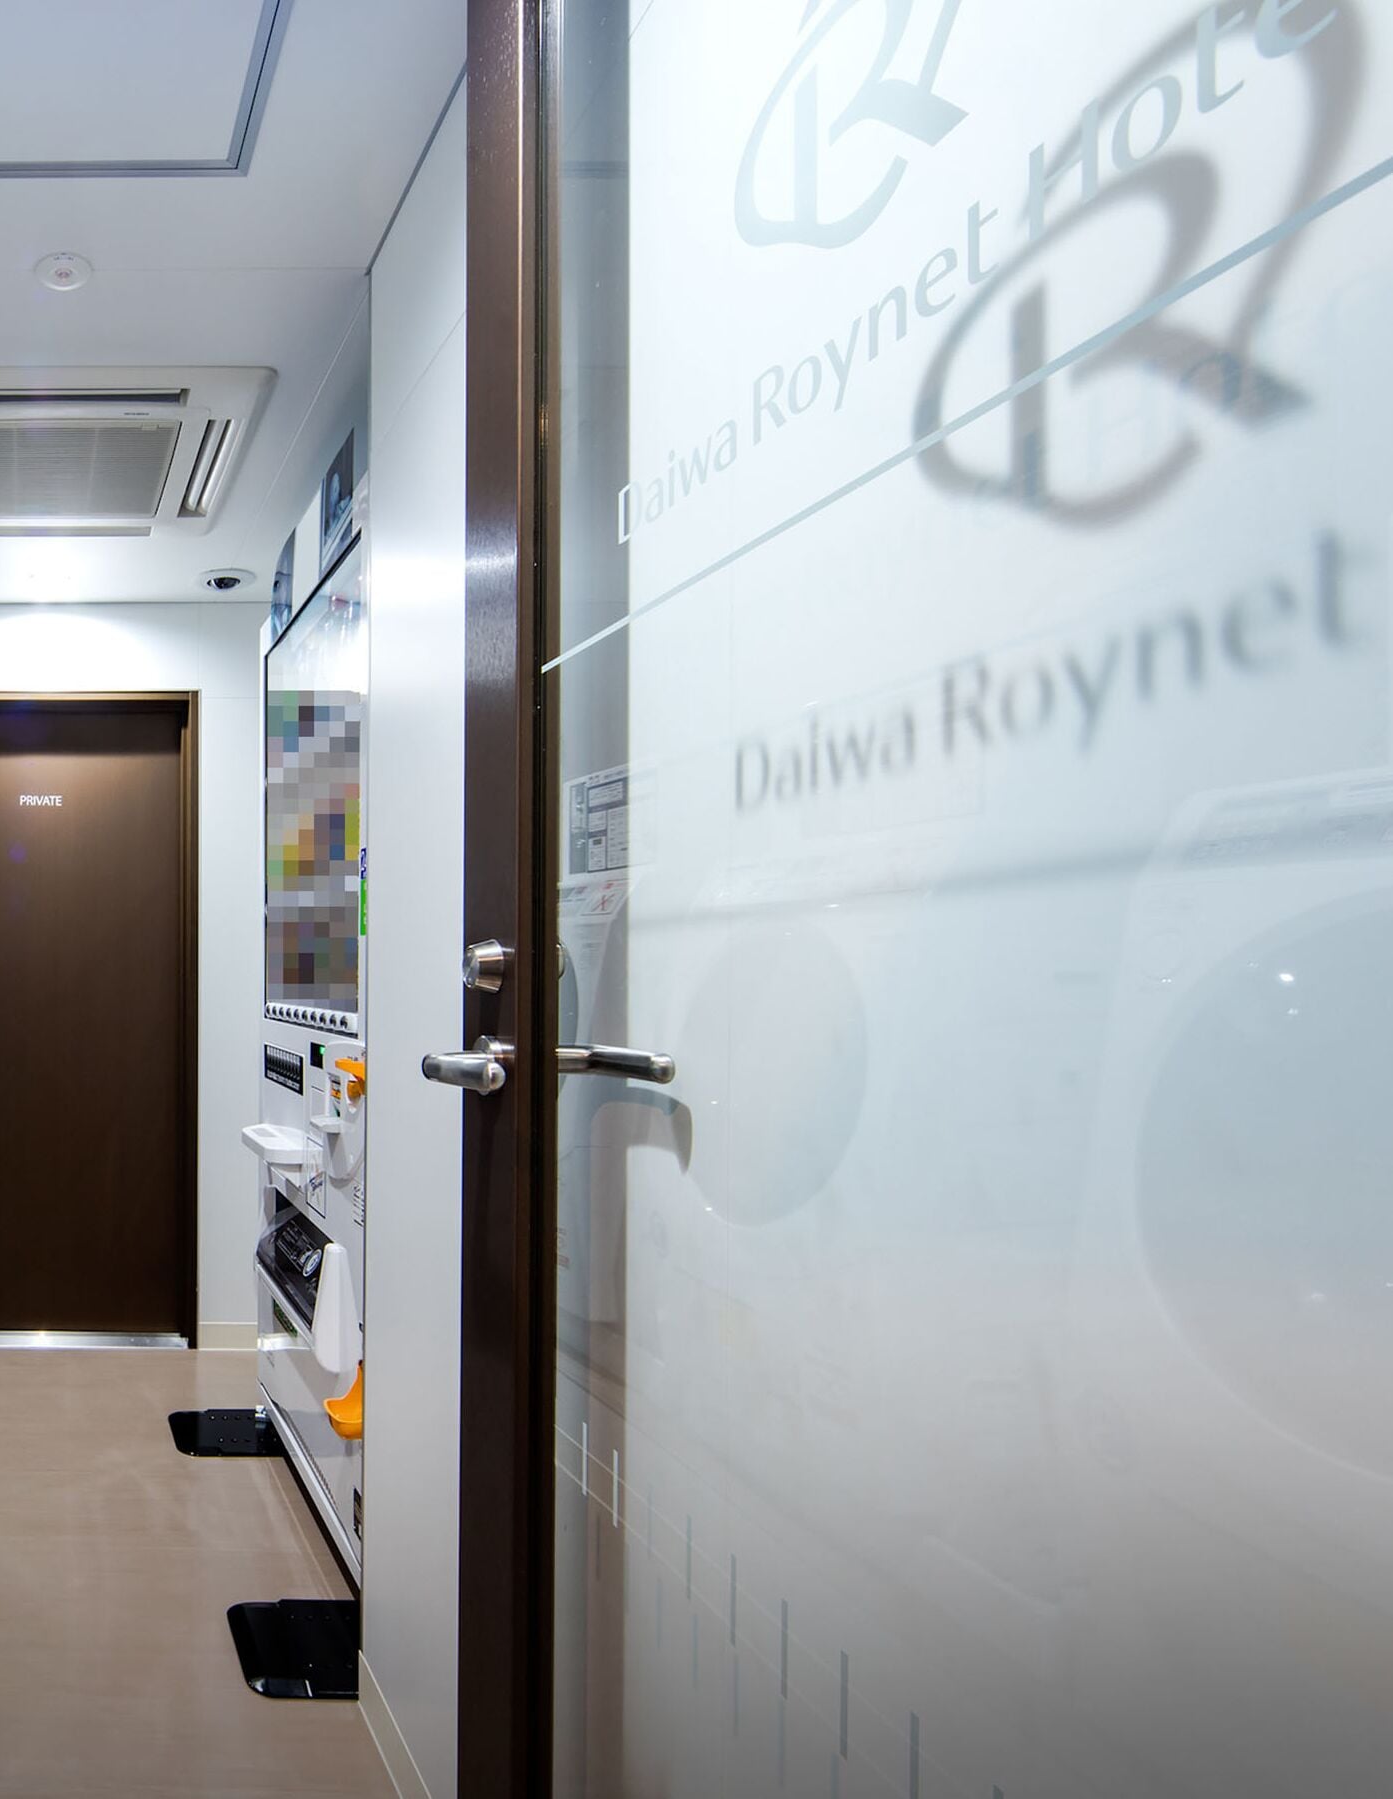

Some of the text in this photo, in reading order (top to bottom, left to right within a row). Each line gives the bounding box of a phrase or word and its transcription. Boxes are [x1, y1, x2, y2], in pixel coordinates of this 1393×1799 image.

[617, 418, 738, 545] Daiwa
[751, 200, 1000, 445] Roynet
[20, 795, 62, 806] PRIVATE
[732, 707, 917, 811] Daiwa
